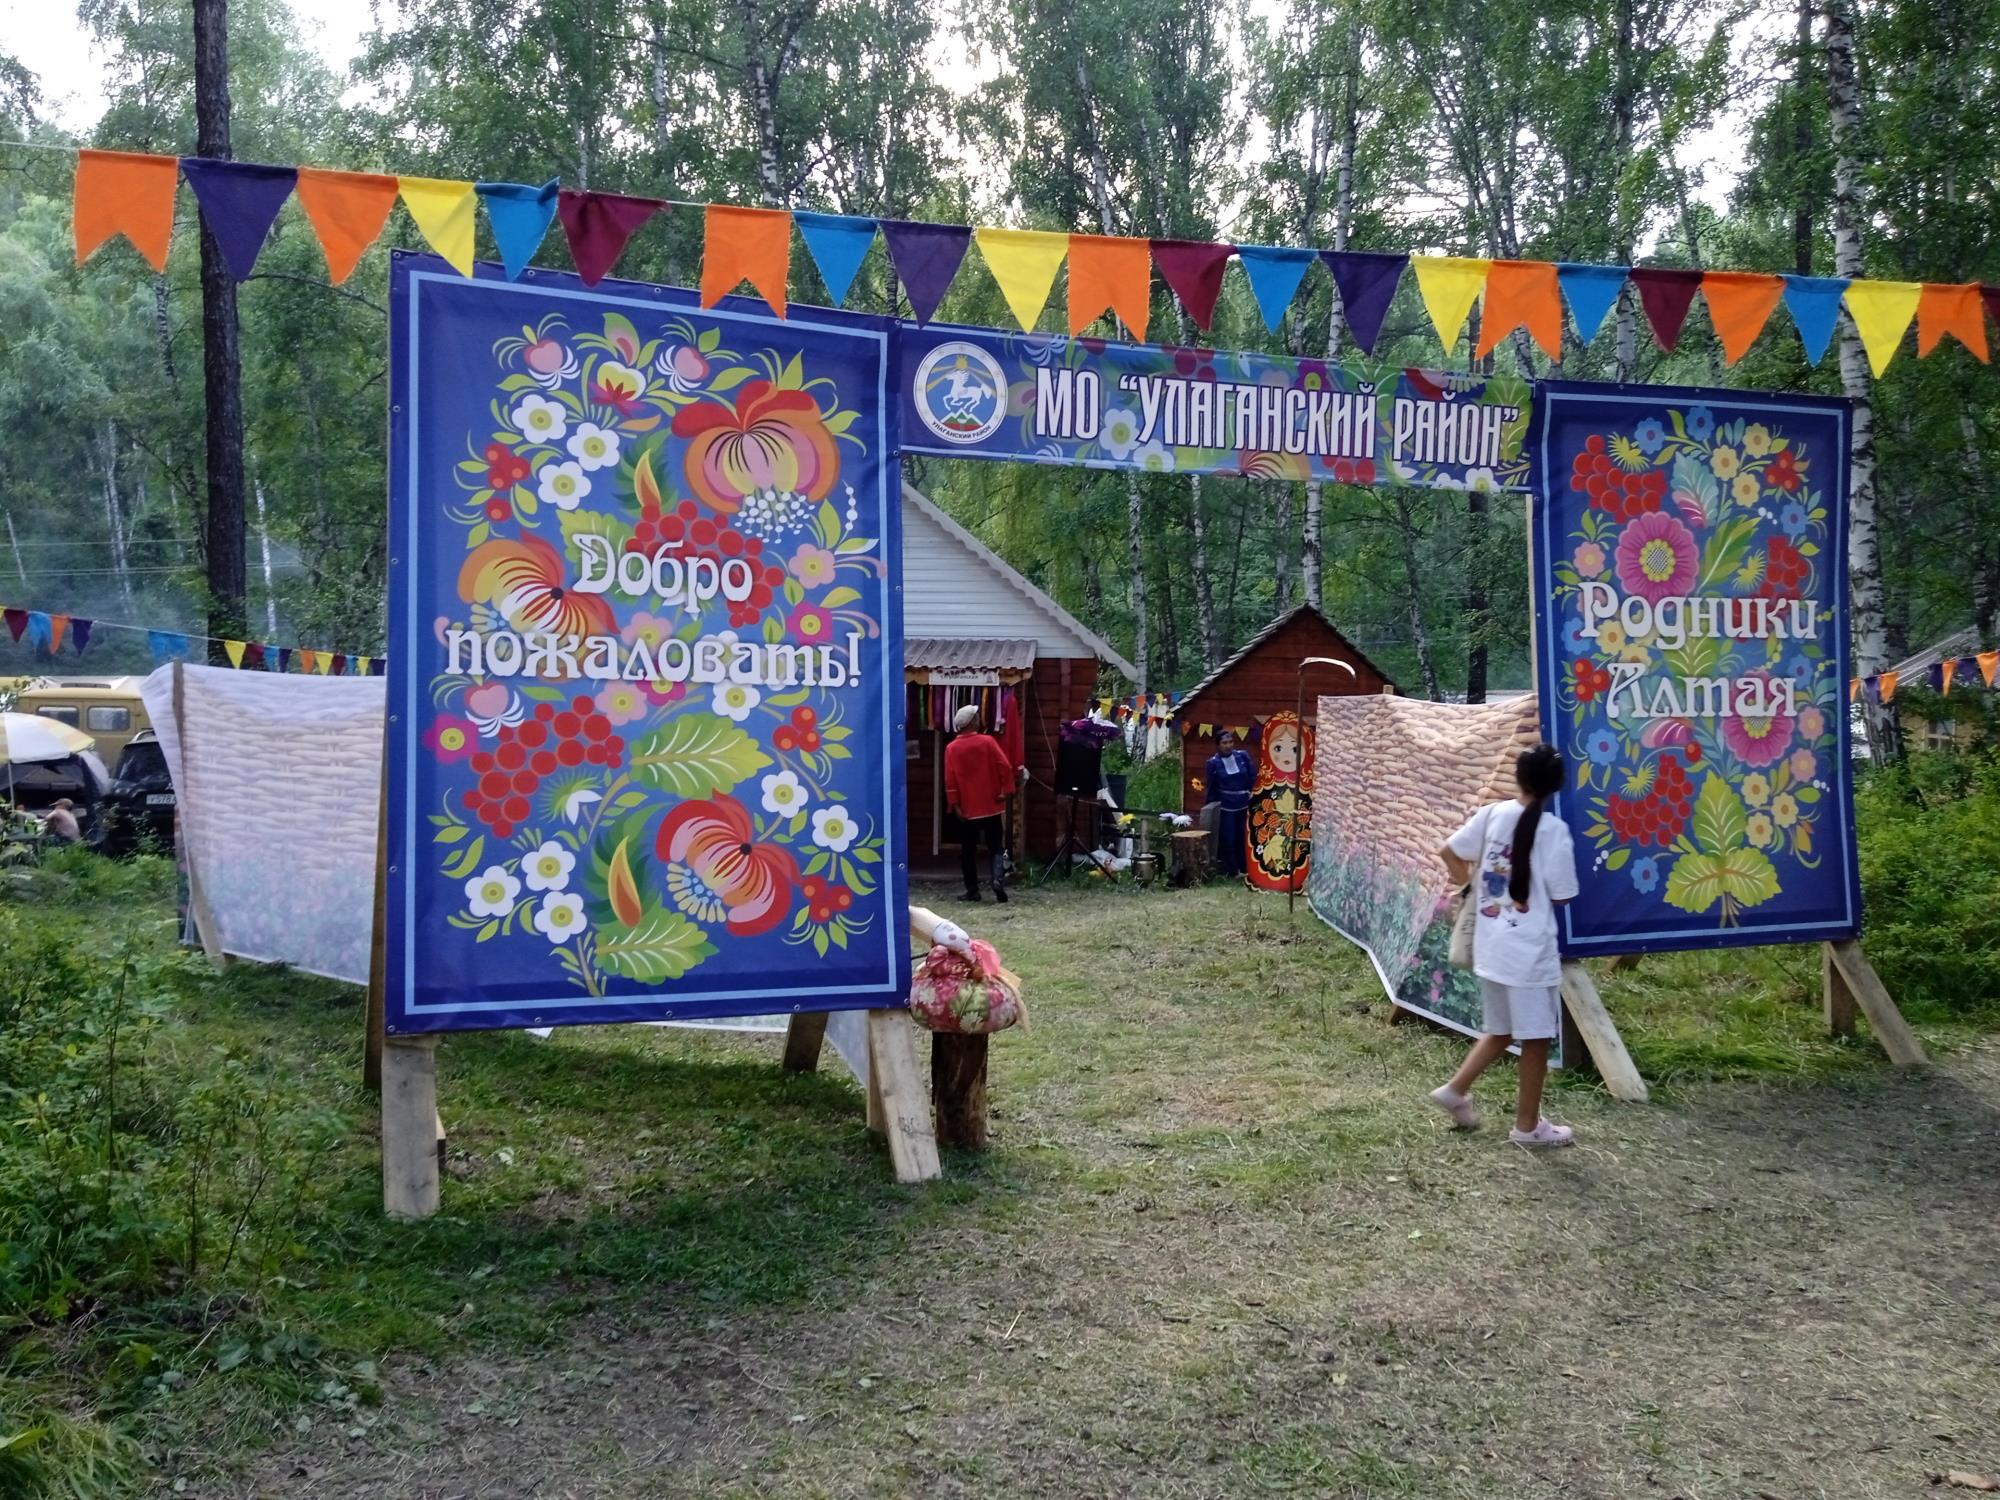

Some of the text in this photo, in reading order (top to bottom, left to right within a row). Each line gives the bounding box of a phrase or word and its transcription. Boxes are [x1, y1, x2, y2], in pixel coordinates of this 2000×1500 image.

[1035, 366, 1100, 440] МО
[572, 533, 754, 621] Добро
[1578, 581, 1819, 650] Родники
[444, 629, 863, 688] пожаловать!
[1605, 662, 1798, 718] Алтая
